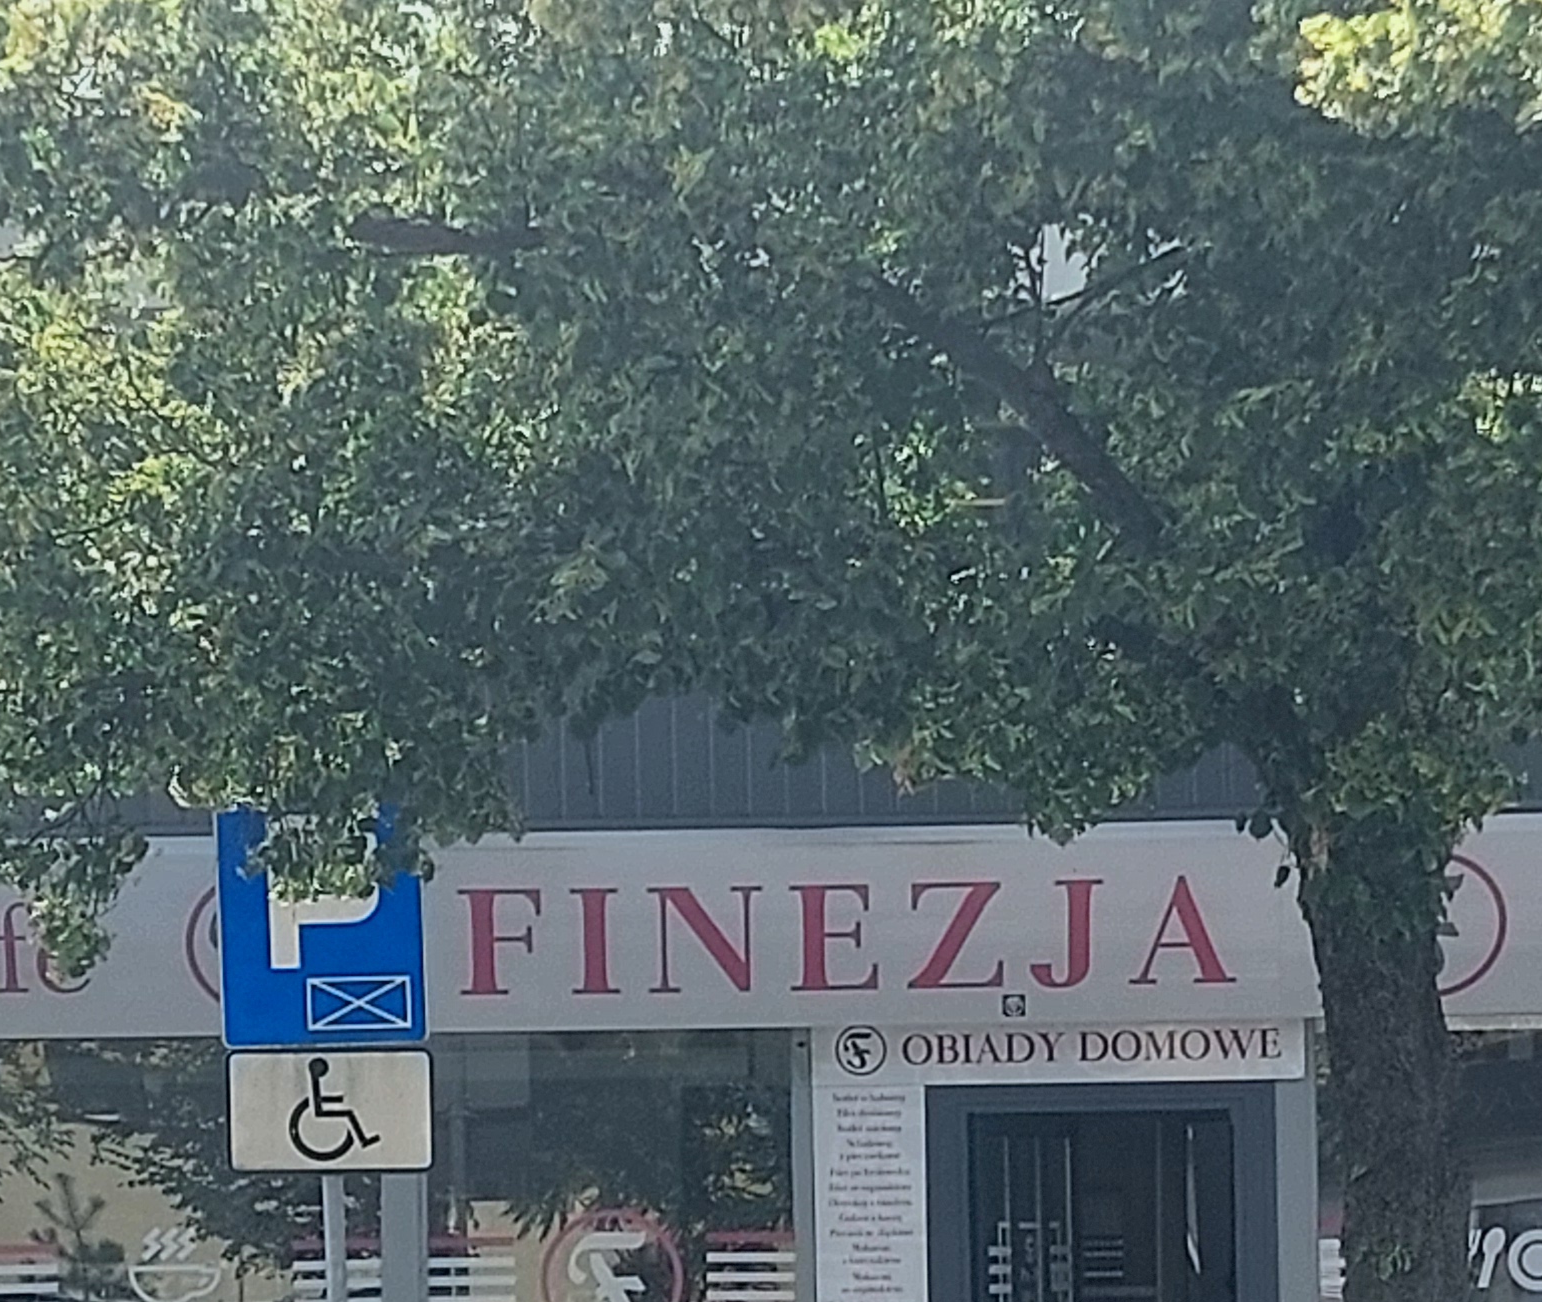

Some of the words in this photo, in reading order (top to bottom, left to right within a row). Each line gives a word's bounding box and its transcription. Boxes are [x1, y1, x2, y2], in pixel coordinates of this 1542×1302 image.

[266, 815, 380, 969] P
[458, 875, 1238, 995] FINEZJA
[902, 1030, 1064, 1066] OBIADY
[1079, 1027, 1283, 1062] DOMOWE
